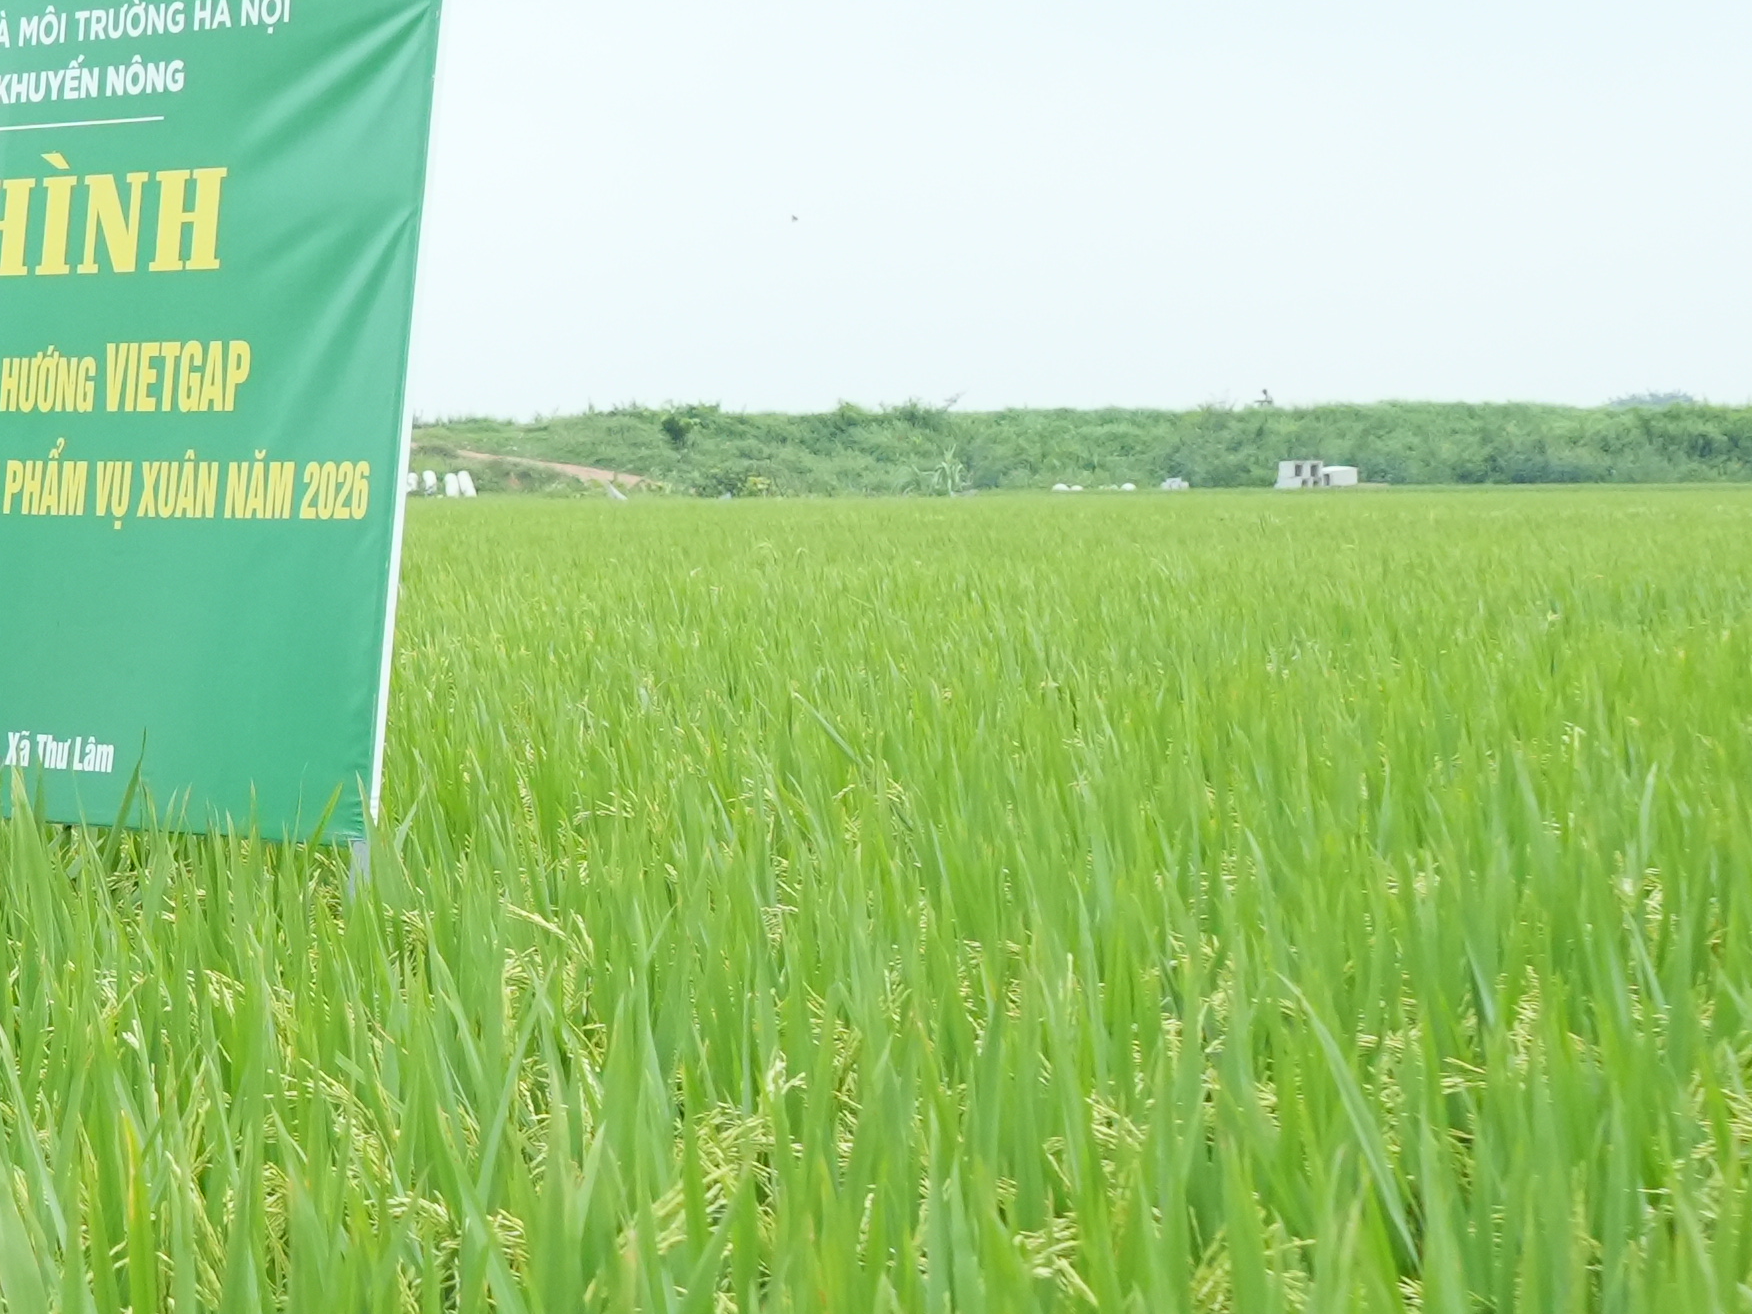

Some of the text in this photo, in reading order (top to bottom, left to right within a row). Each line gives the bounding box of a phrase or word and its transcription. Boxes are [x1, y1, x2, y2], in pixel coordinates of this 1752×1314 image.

[18, 6, 67, 47] MÔI
[75, 0, 186, 43] TRƯỜNG
[106, 55, 185, 96] NÔNG
[0, 345, 97, 413] HƯỚNG
[106, 340, 251, 412] VIETGAP
[3, 437, 88, 515] PHẨM
[96, 461, 132, 530] VỤ
[136, 449, 219, 519] XUÂN
[224, 449, 295, 519] NĂM
[299, 461, 370, 520] 2026
[5, 731, 30, 767] Xã
[37, 734, 71, 770] Thư
[73, 736, 114, 773] Lâm
